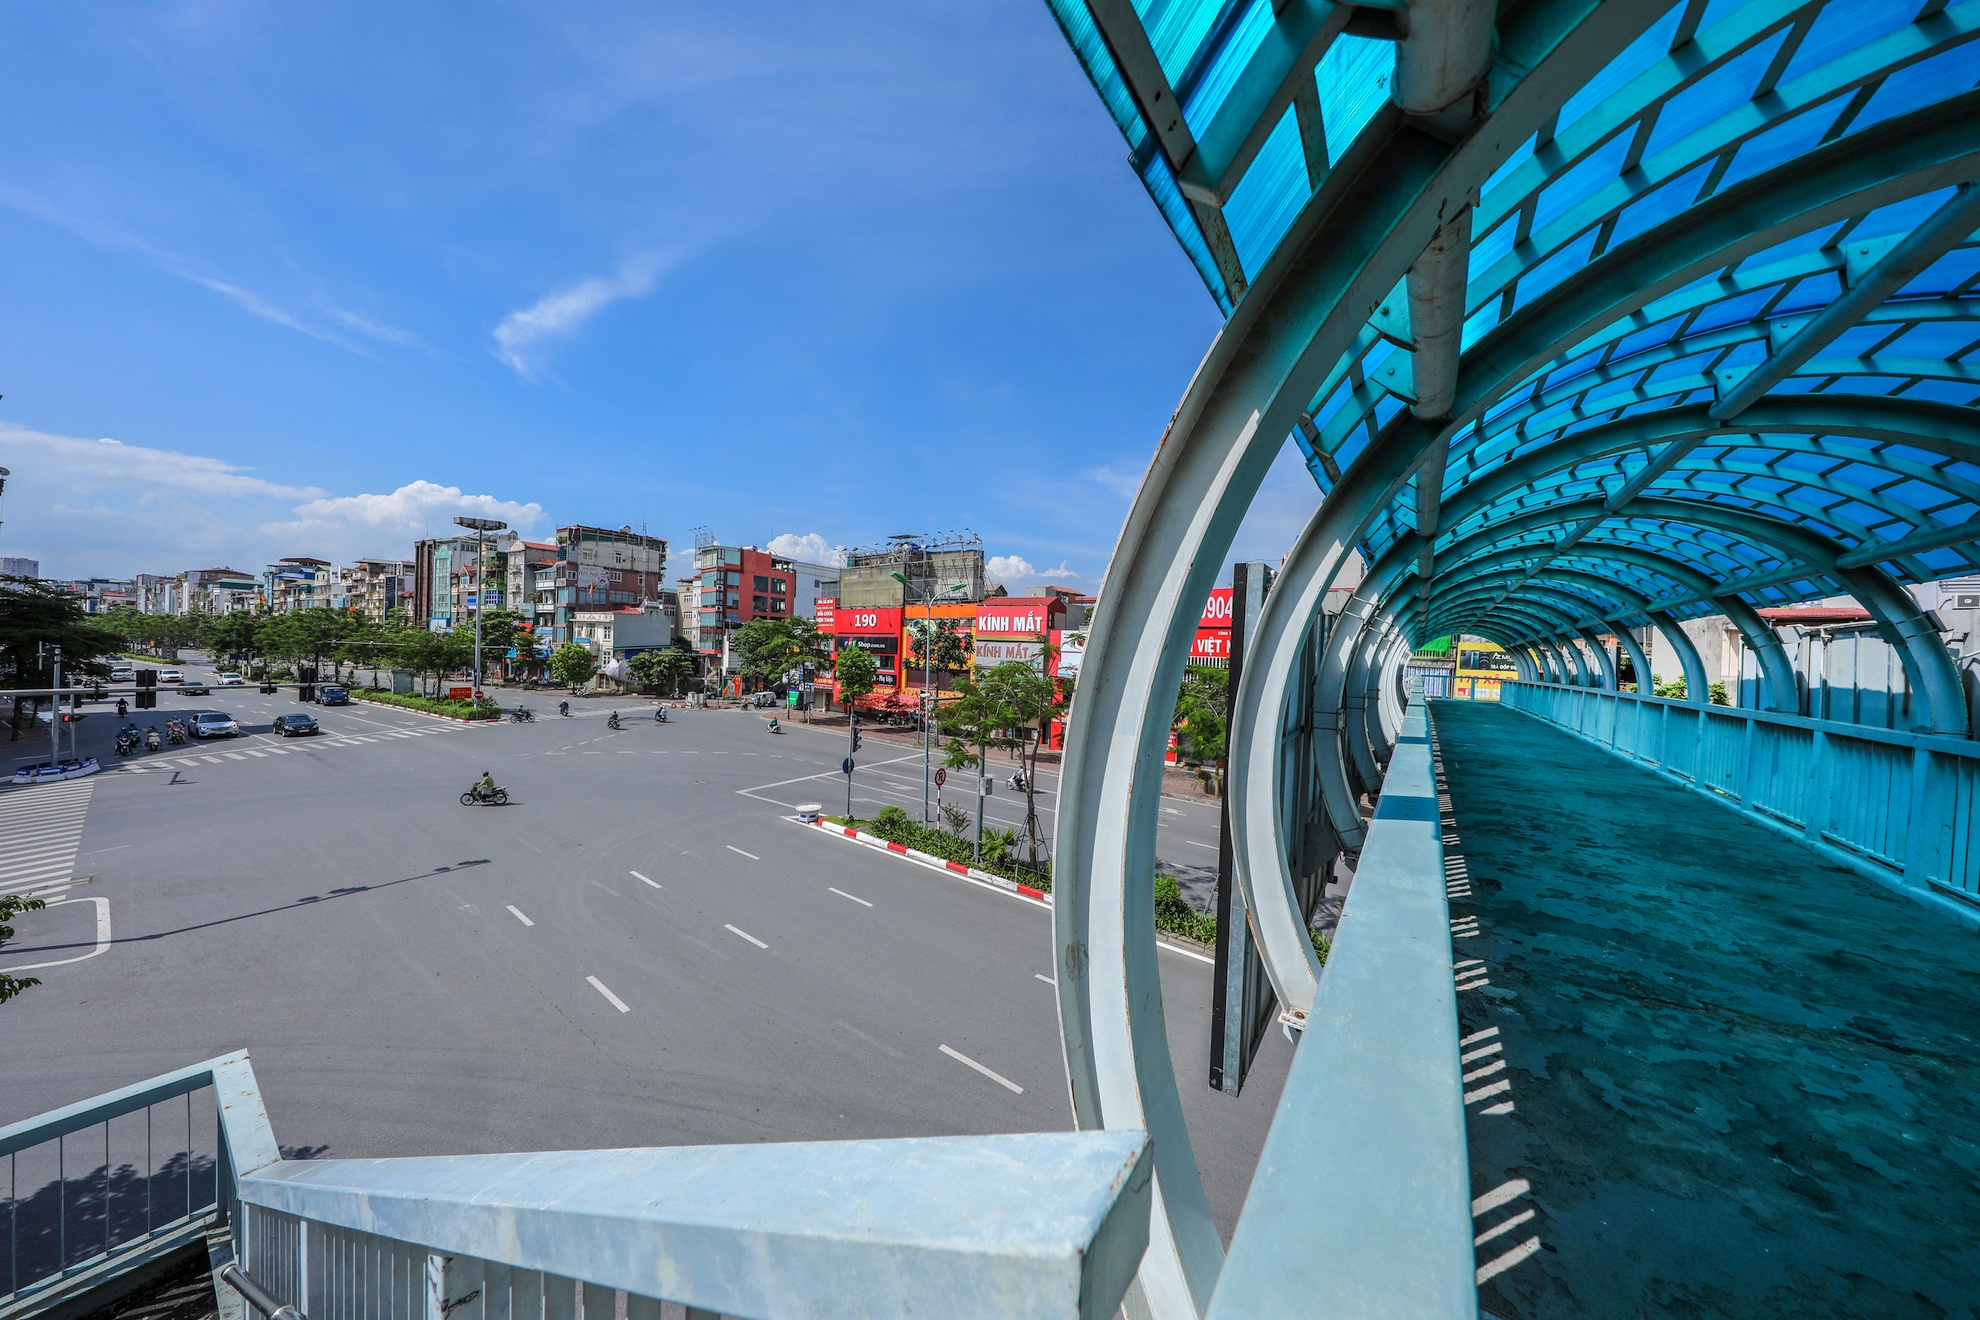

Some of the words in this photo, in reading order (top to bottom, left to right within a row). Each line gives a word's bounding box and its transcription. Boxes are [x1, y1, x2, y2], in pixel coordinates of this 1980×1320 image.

[854, 614, 877, 626] 190
[979, 612, 1009, 632] KÍNH
[1013, 610, 1043, 632] MẮT
[976, 643, 1001, 658] KÍNH
[1006, 642, 1029, 659] MẮT
[1197, 636, 1222, 656] VIỆT
